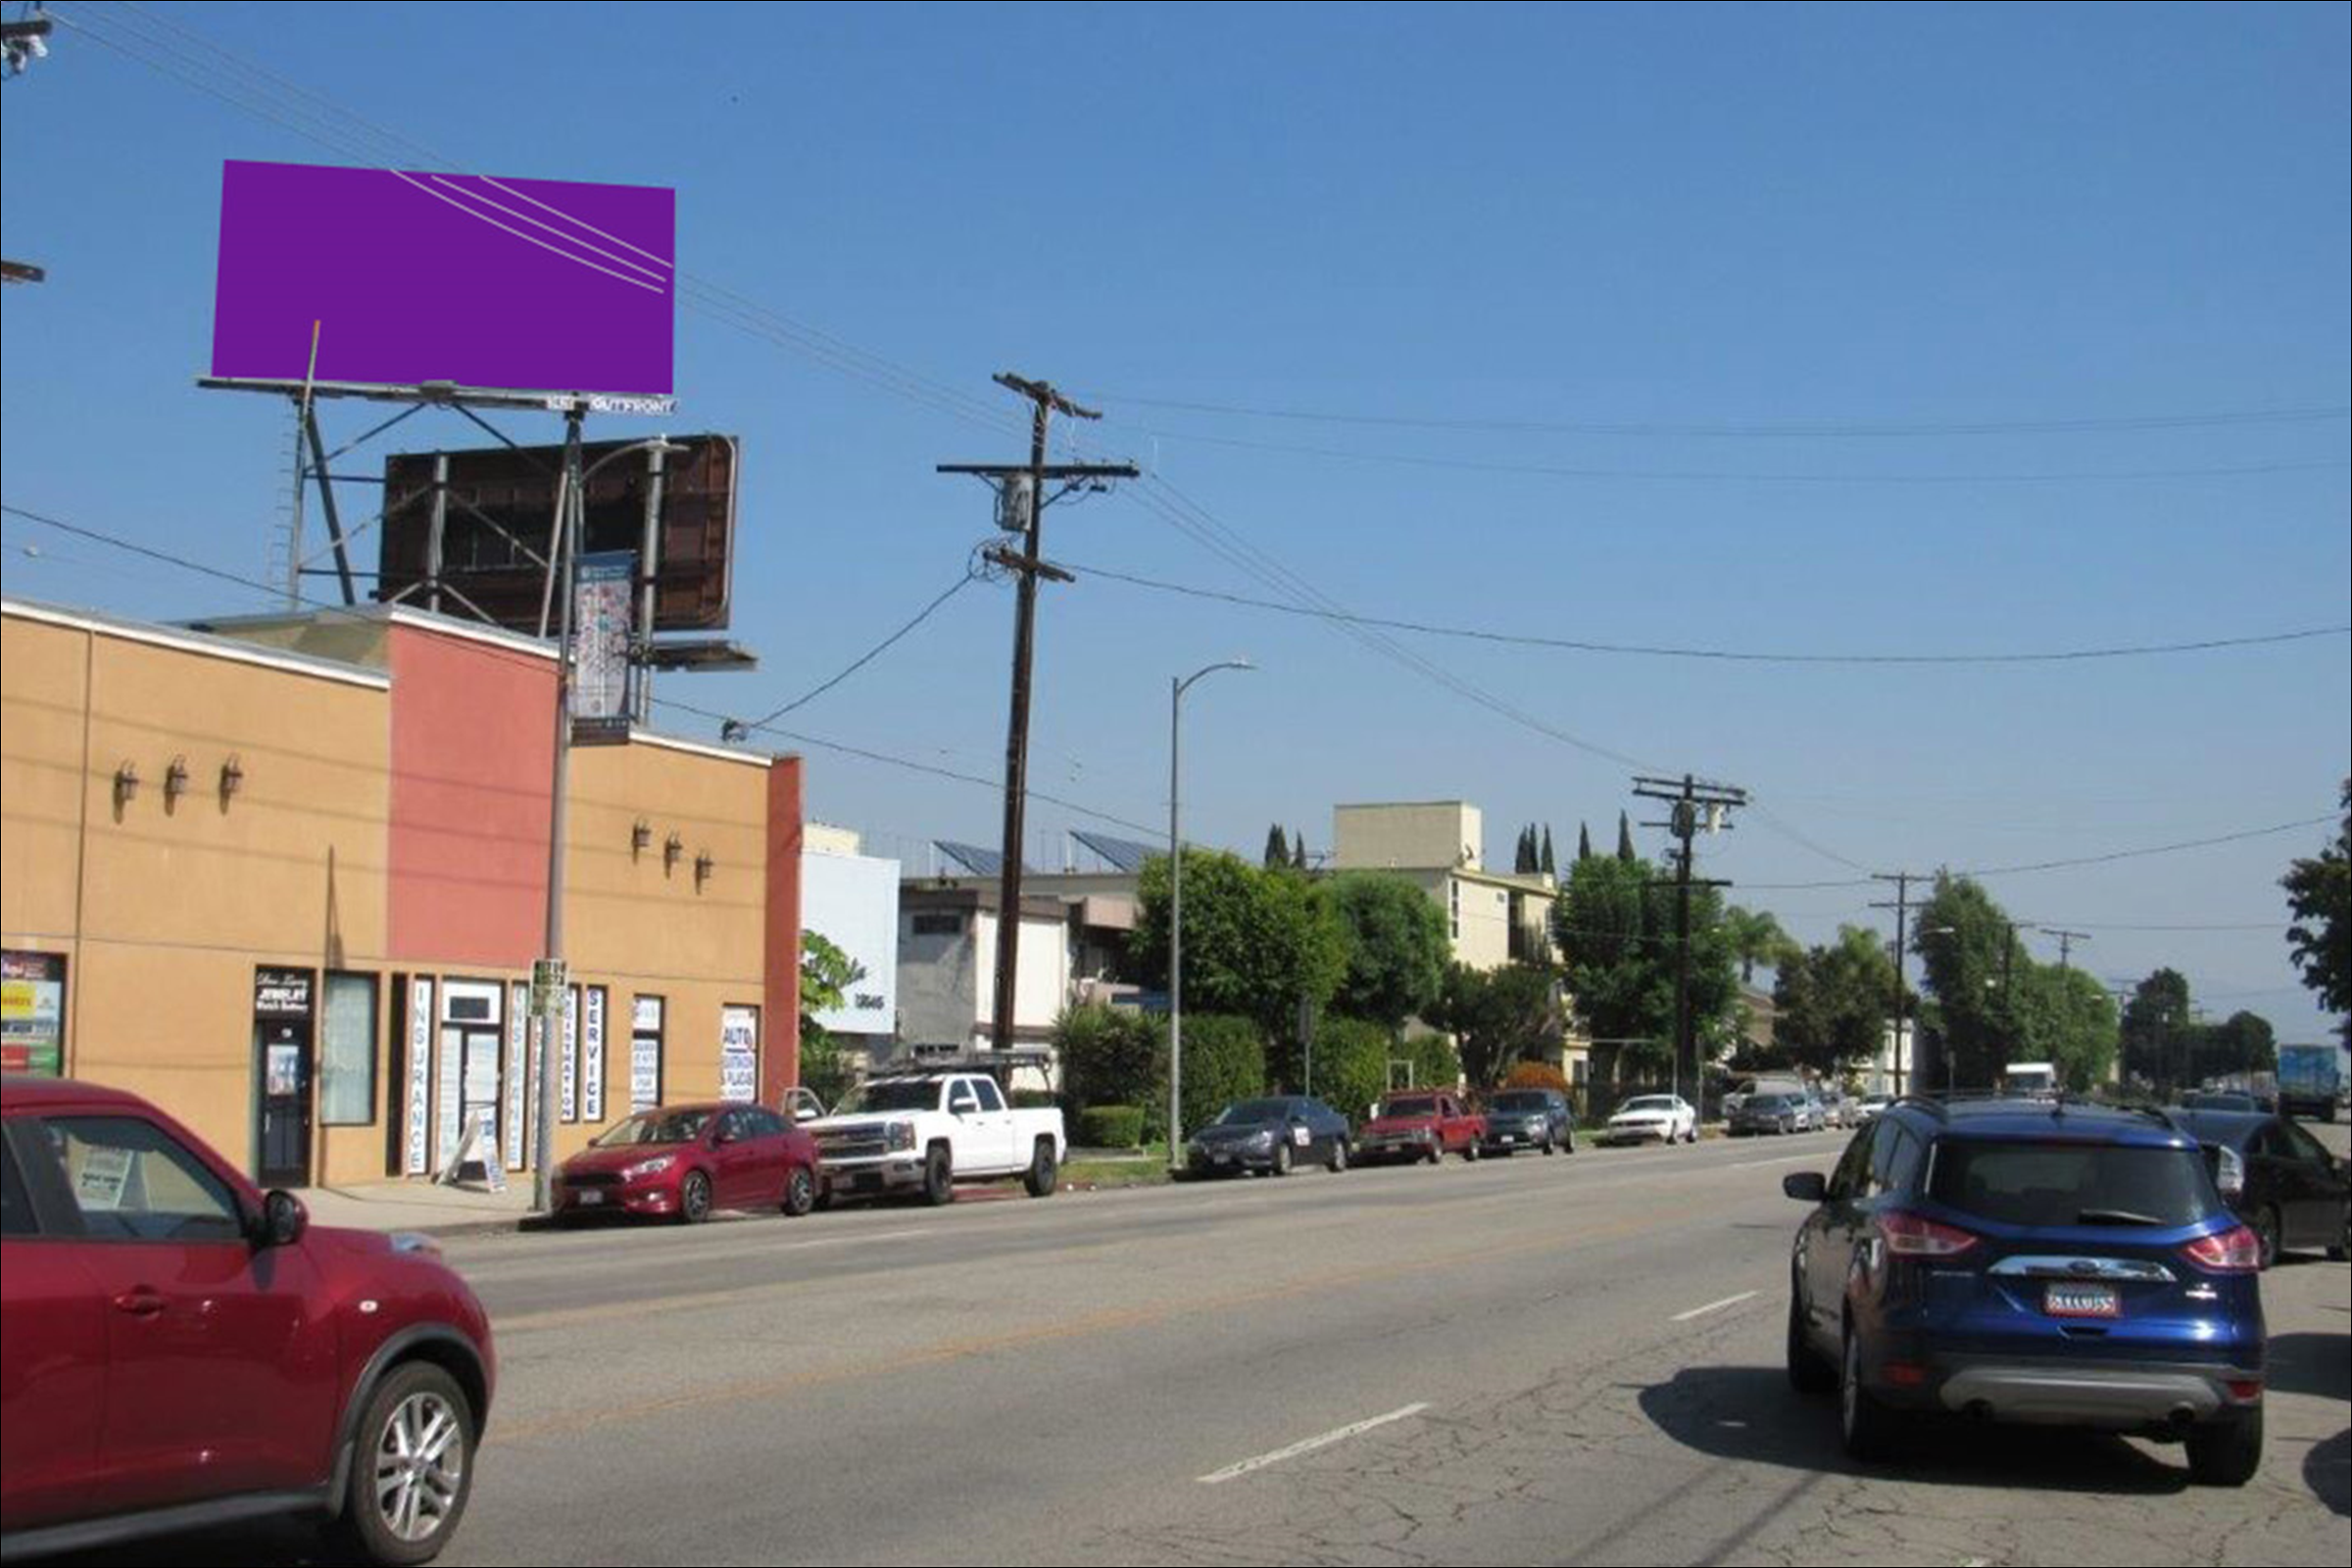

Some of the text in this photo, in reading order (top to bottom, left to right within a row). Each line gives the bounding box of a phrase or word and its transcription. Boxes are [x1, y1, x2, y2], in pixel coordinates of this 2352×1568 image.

[589, 395, 678, 416] OUTFRONT
[587, 990, 599, 1114] SERVICE
[723, 1027, 753, 1046] AUTO
[411, 987, 425, 1168] INSURANCE
